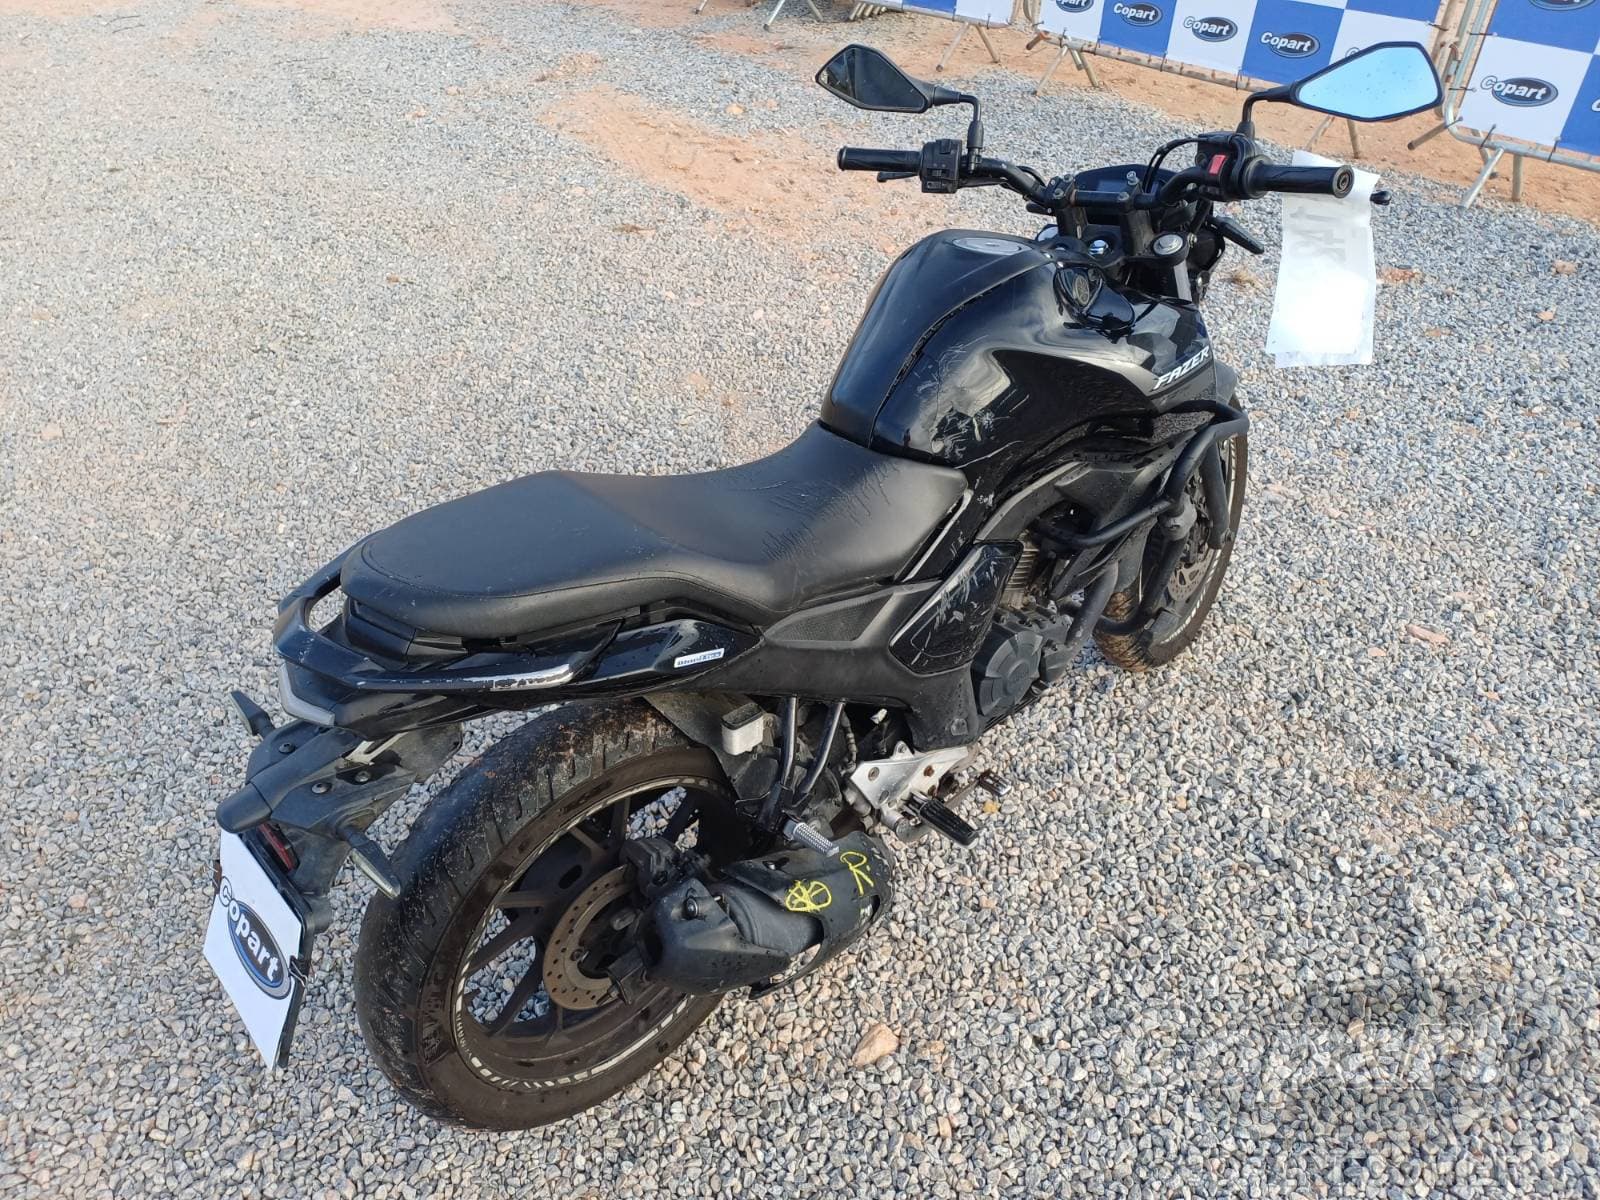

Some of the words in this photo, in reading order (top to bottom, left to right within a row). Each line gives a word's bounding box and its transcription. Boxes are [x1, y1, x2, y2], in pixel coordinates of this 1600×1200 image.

[1113, 3, 1156, 21] Copart
[1184, 16, 1231, 36] Copart
[1260, 31, 1312, 52] Copart
[1481, 75, 1548, 100] Copart
[1152, 345, 1210, 391] FAZER
[219, 875, 280, 983] Copart
